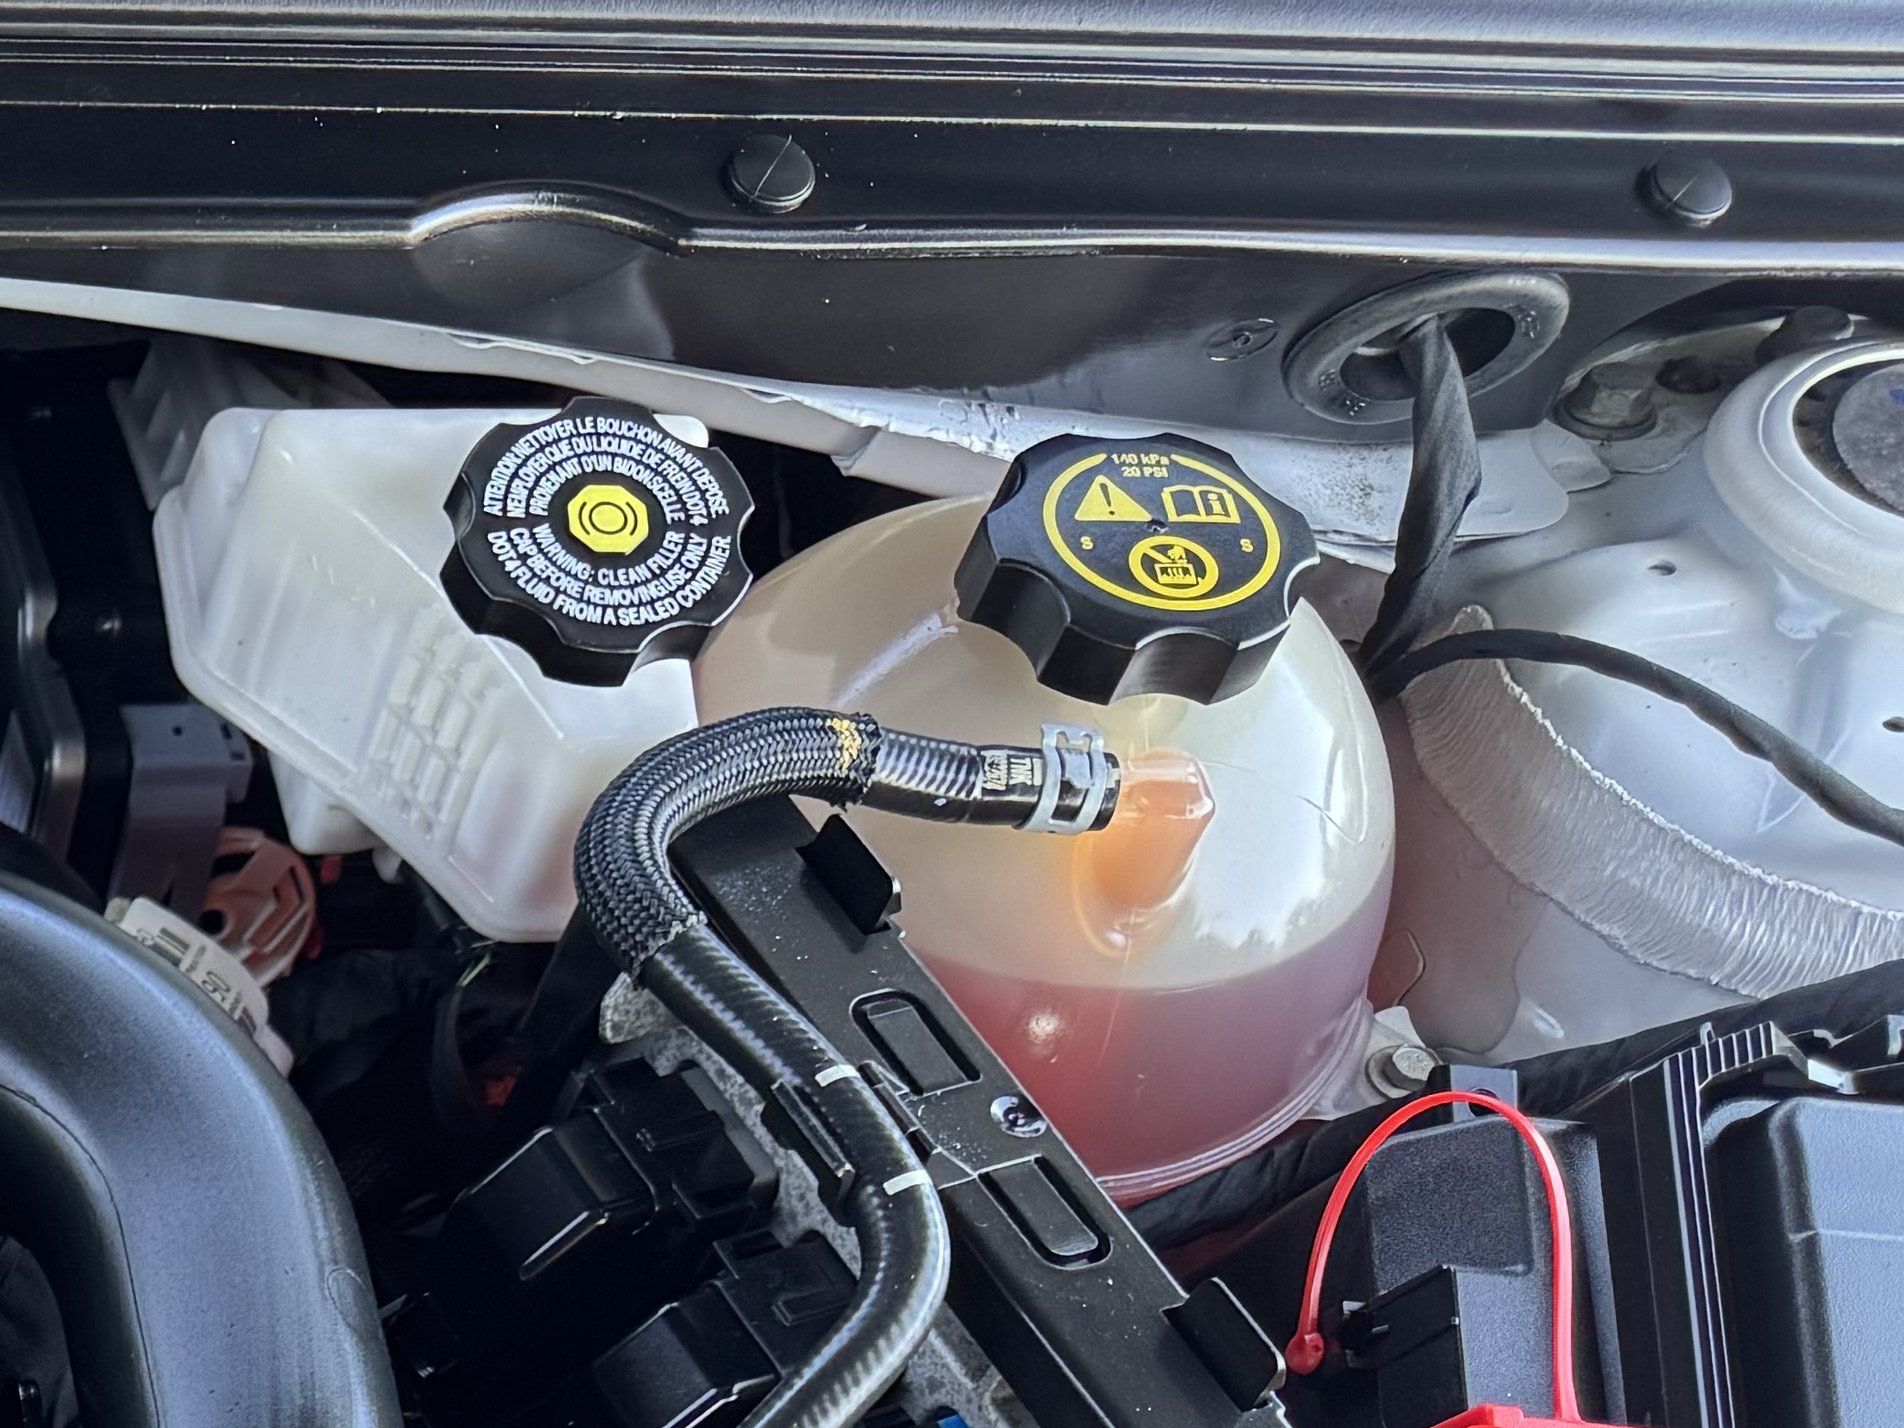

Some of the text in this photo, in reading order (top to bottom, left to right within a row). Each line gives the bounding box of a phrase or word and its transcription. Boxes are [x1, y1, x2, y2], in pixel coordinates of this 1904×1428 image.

[511, 419, 577, 460] NETTOYER
[576, 417, 596, 434] LE
[596, 417, 662, 447] BOUCHON
[657, 438, 703, 473] AVANT
[571, 436, 593, 454] DU
[642, 448, 665, 469] DE
[487, 531, 518, 561] DOT
[510, 565, 556, 604] FLUID
[553, 594, 603, 625] FROM
[603, 607, 617, 626] A
[616, 597, 680, 626] SEALED
[509, 527, 538, 555] CAP
[526, 553, 584, 599] BEFORE
[659, 563, 693, 591] USE
[681, 532, 708, 569] ONLY
[597, 563, 652, 585] CLEAN
[646, 530, 685, 574] FILLER
